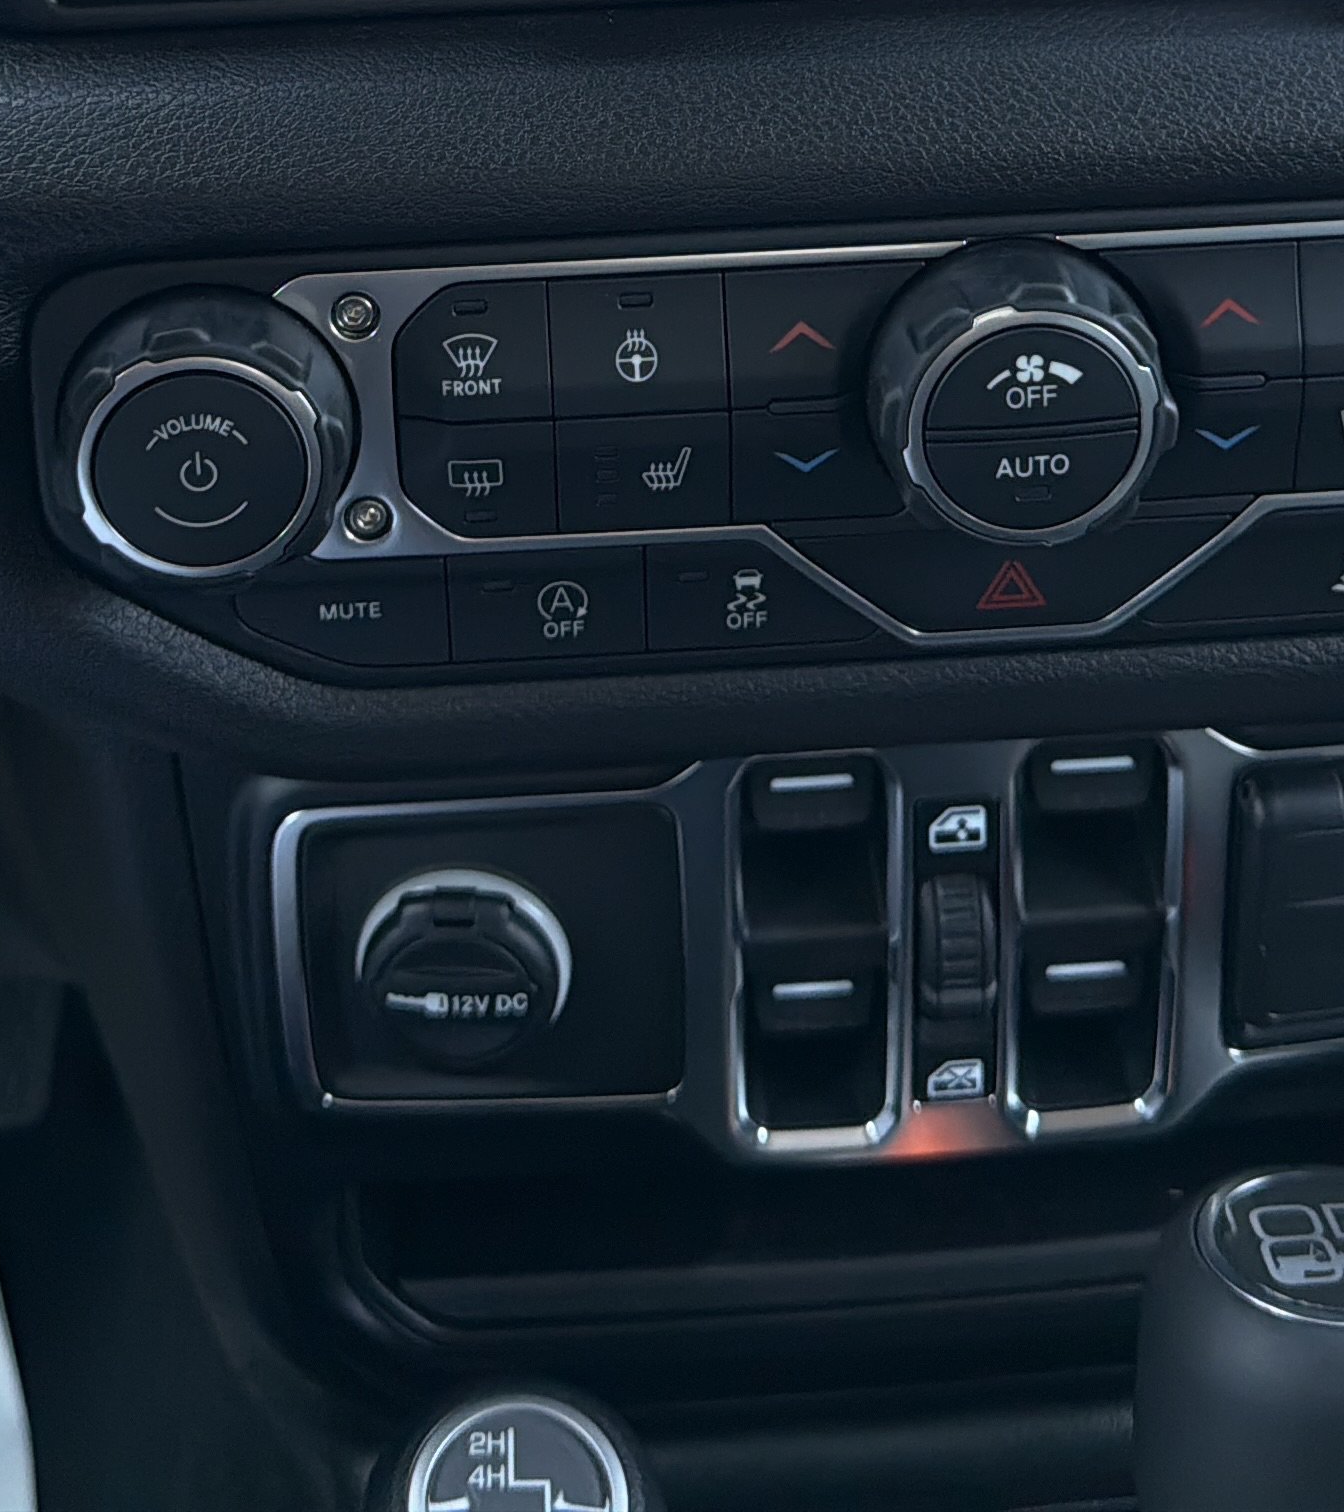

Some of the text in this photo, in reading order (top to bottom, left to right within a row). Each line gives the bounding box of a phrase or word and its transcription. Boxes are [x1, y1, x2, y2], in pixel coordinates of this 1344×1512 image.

[442, 378, 502, 396] FRONT
[1006, 385, 1058, 409] OFF
[157, 416, 233, 440] VOLUME
[996, 453, 1070, 479] AUTO
[319, 601, 382, 621] MUTE
[726, 610, 768, 629] OFF
[543, 619, 584, 638] OFF
[452, 992, 528, 1018] 12V DC
[468, 1430, 506, 1458] 2H
[467, 1463, 506, 1490] 4H
